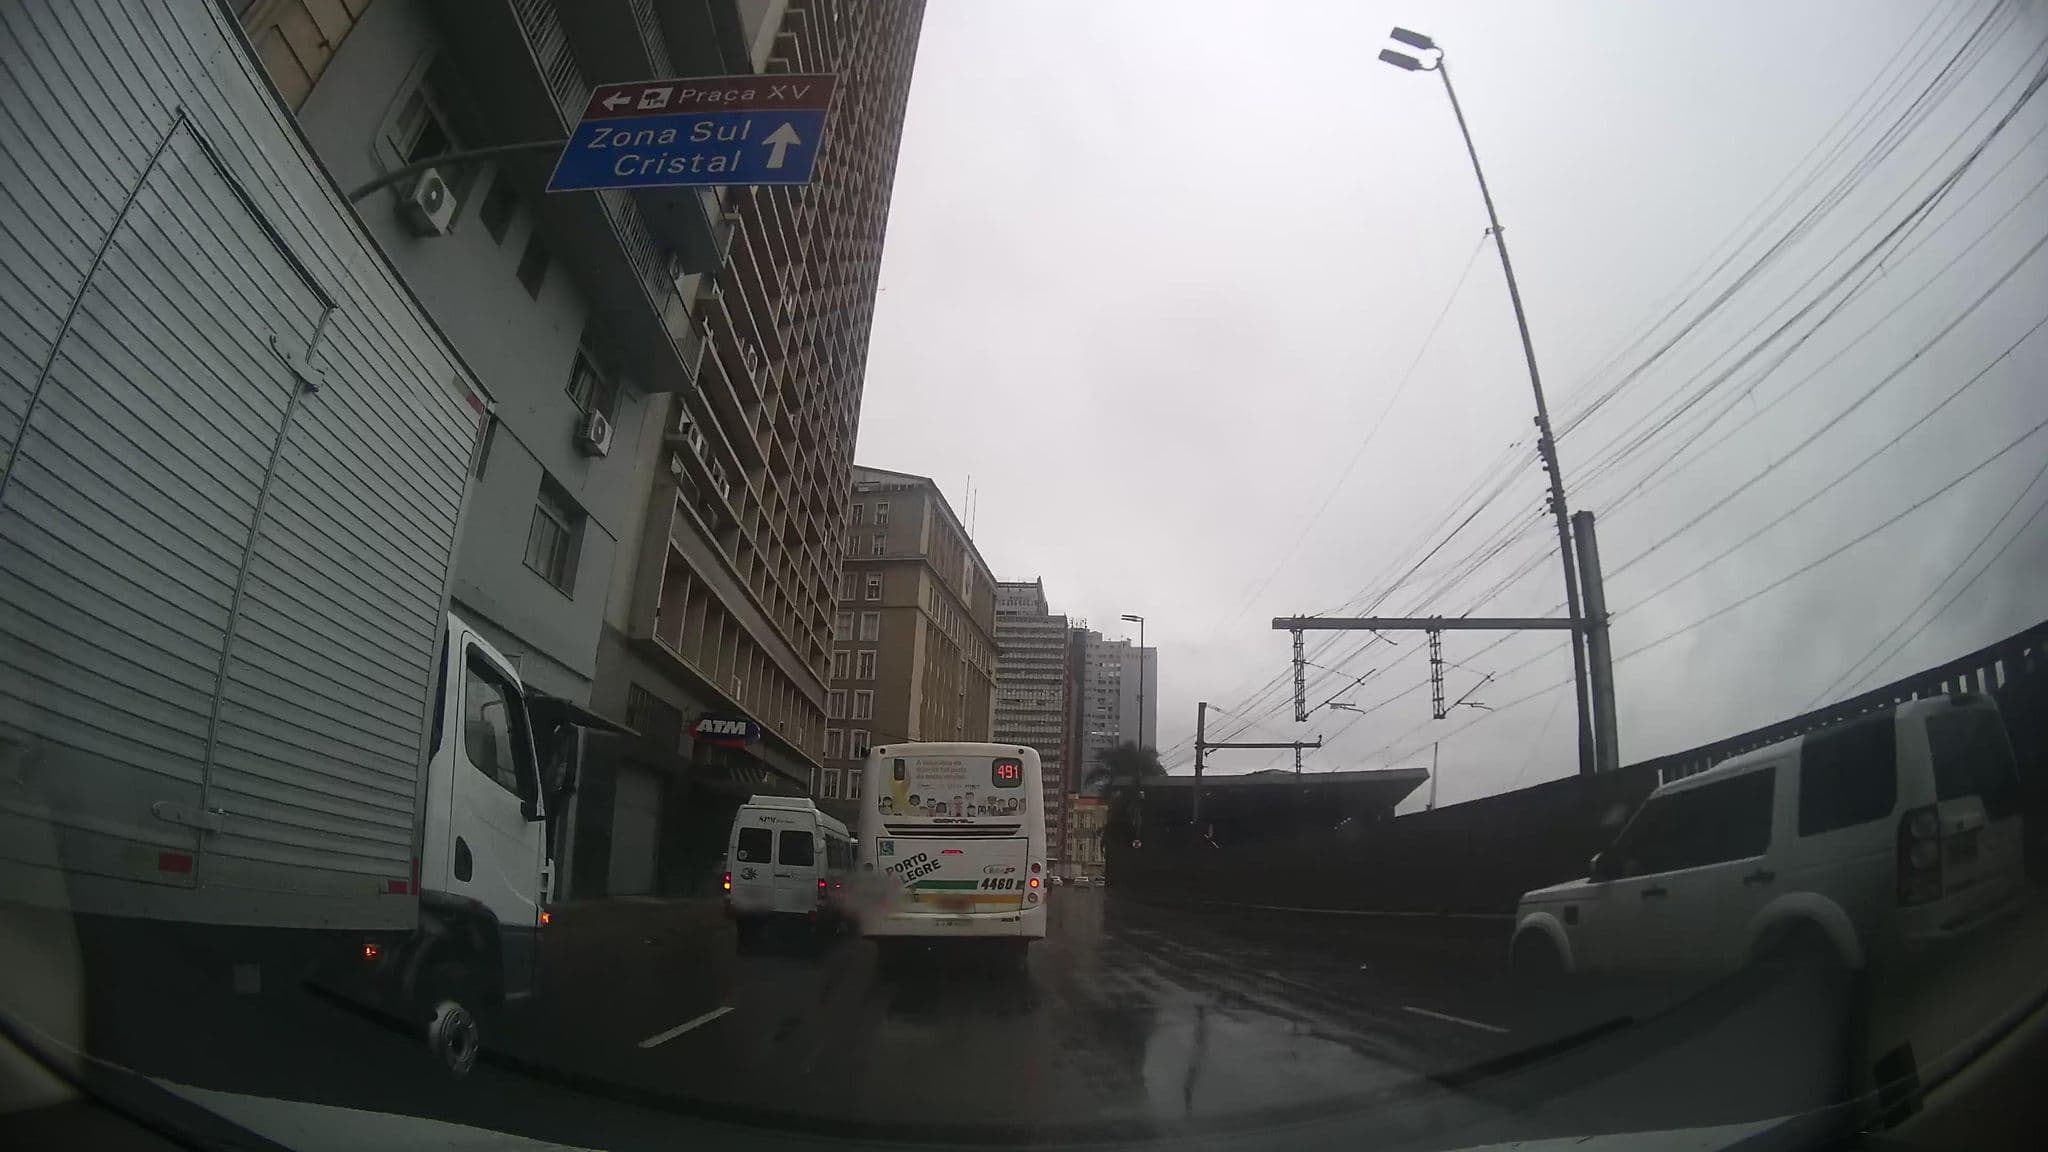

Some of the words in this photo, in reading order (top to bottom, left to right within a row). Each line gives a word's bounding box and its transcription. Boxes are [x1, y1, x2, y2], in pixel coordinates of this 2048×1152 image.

[678, 88, 754, 105] Praça
[767, 84, 810, 101] XV
[588, 126, 677, 150] Zona
[690, 120, 752, 143] Sul
[614, 149, 741, 177] Cristal
[695, 718, 747, 736] ATM
[997, 765, 1018, 779] 491
[886, 853, 928, 876] PORTO
[901, 859, 942, 884] LEGRE
[981, 877, 1014, 890] 4460
